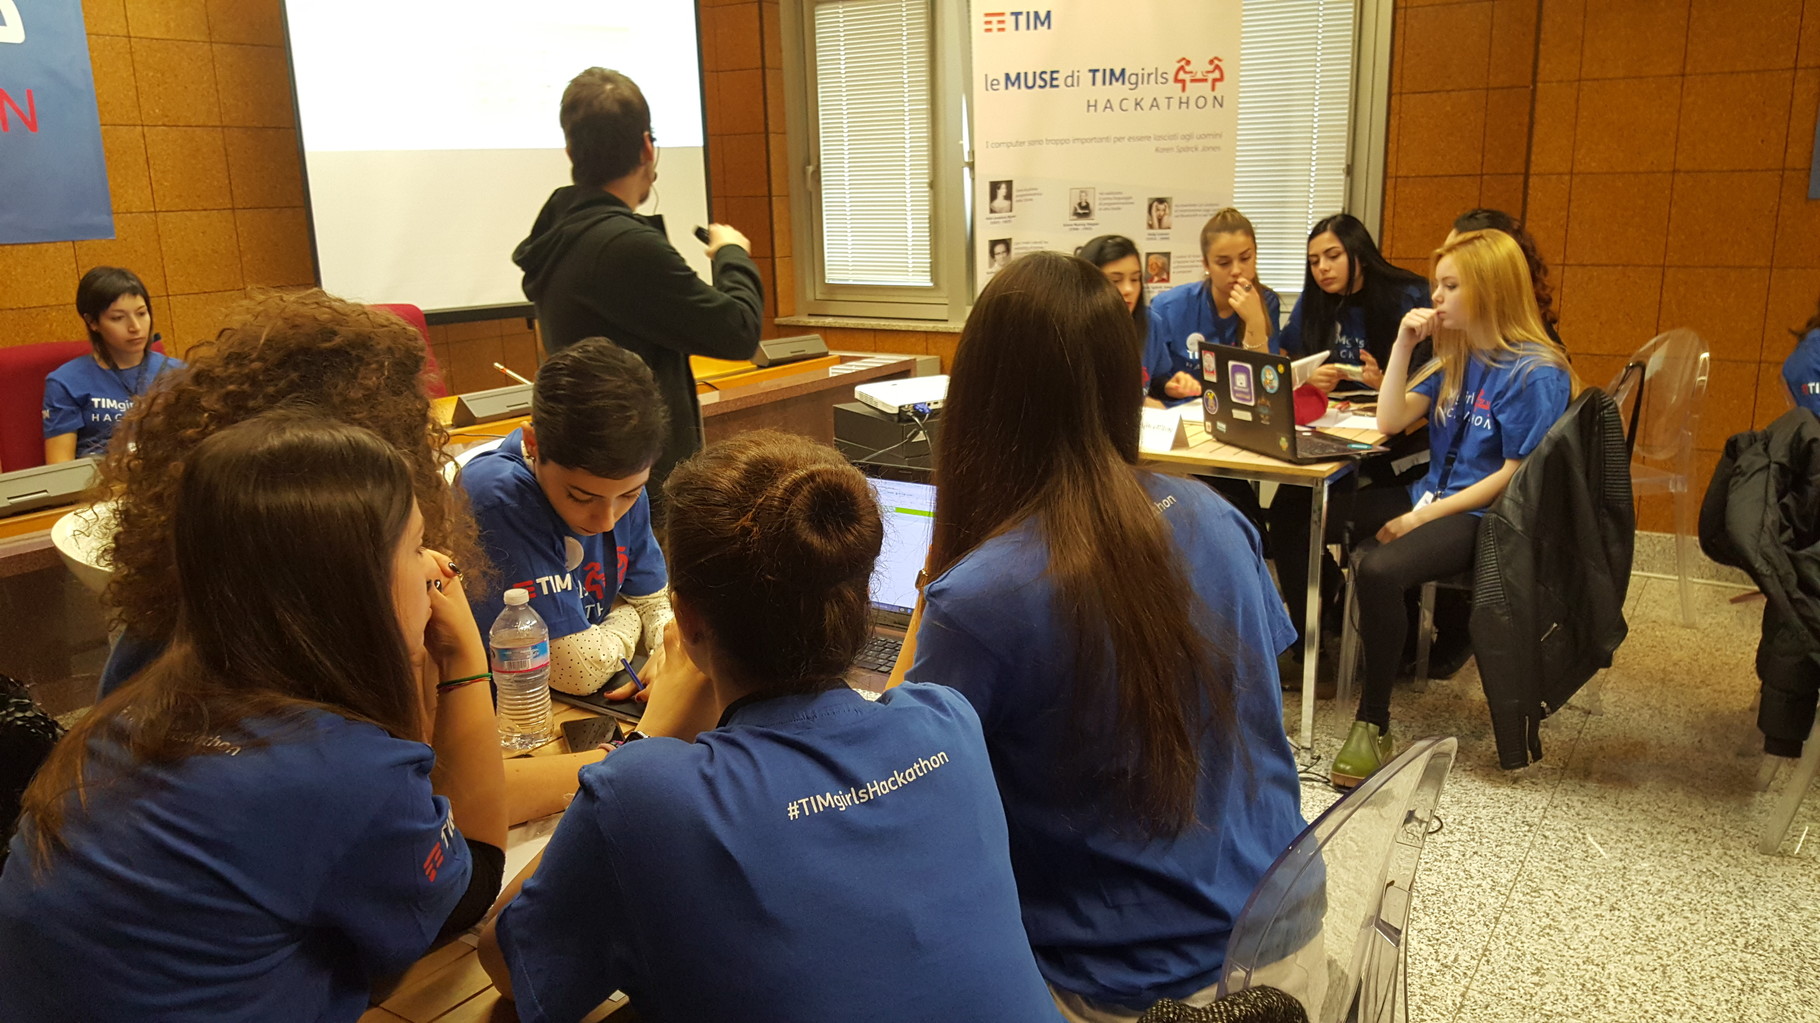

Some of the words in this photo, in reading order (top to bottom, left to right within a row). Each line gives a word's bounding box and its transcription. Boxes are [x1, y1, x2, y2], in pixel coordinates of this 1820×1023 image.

[1010, 10, 1052, 31] TIM
[984, 74, 1000, 91] le
[1004, 70, 1060, 90] MUSE
[1064, 70, 1081, 88] di
[1088, 67, 1169, 90] TIMgirls
[1086, 95, 1225, 113] HACKATHON
[1808, 382, 1820, 395] TI
[91, 397, 134, 412] TIMgir
[536, 572, 573, 595] TIM
[787, 751, 949, 821] #TIMgirlsHackathon
